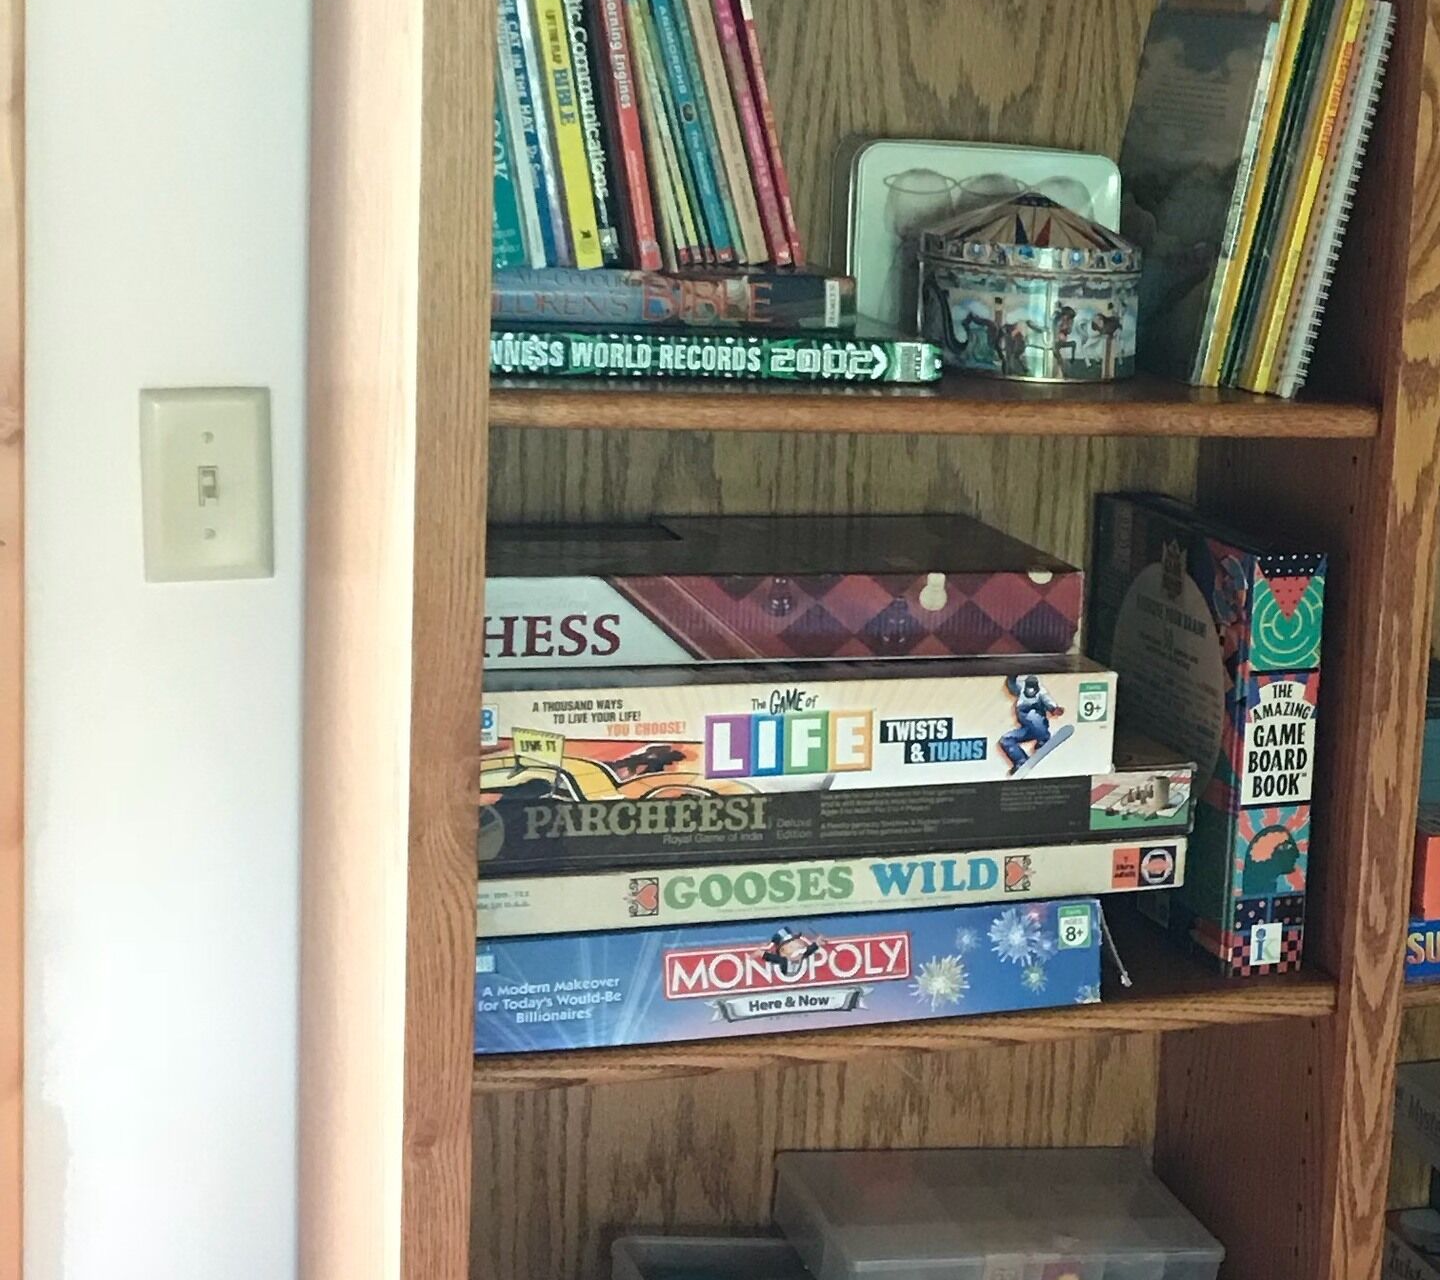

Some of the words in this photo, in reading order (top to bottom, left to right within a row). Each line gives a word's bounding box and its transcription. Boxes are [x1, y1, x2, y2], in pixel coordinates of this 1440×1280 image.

[610, 53, 635, 109] Engines
[567, 25, 615, 199] Communications
[642, 278, 776, 324] BIBLE
[571, 341, 653, 372] WORLD
[659, 342, 762, 373] RECORDS
[769, 346, 874, 376] 2002
[484, 614, 621, 658] HESS
[751, 696, 767, 712] The
[768, 688, 805, 715] GAME
[805, 694, 820, 710] of
[1271, 683, 1294, 699] THE
[532, 701, 540, 713] A
[542, 699, 594, 713] THOUSAND
[596, 698, 624, 711] WAYS
[553, 713, 565, 725] TO
[567, 711, 588, 724] LIVE
[590, 711, 616, 724] YOUR
[618, 710, 642, 723] LIFE!
[1083, 701, 1102, 718] 9+
[1252, 700, 1311, 722] AMAZING
[606, 723, 631, 738] YOU
[634, 721, 688, 737] CHOOSE!
[885, 719, 948, 742] TWISTS
[1252, 721, 1306, 749] GAME
[708, 711, 870, 776] LIFE
[909, 742, 926, 763] &
[928, 740, 985, 762] TURNS
[1247, 747, 1309, 775] BOARD
[1251, 771, 1300, 800] BOOK
[522, 796, 768, 842] PARCHEESI
[663, 864, 854, 910] GOOSES
[869, 857, 1000, 897] WILD
[1064, 924, 1084, 944] 8+
[671, 938, 904, 993] MONOPOLY
[482, 986, 494, 998] A
[497, 982, 551, 998] Modern
[553, 976, 620, 994] Makeover
[477, 1000, 498, 1012] for
[502, 996, 554, 1014] Today's
[556, 990, 622, 1007] Would-Be
[748, 993, 782, 1012] Here
[785, 995, 795, 1010] &
[798, 993, 830, 1008] Now
[515, 1006, 594, 1025] Billionaires
